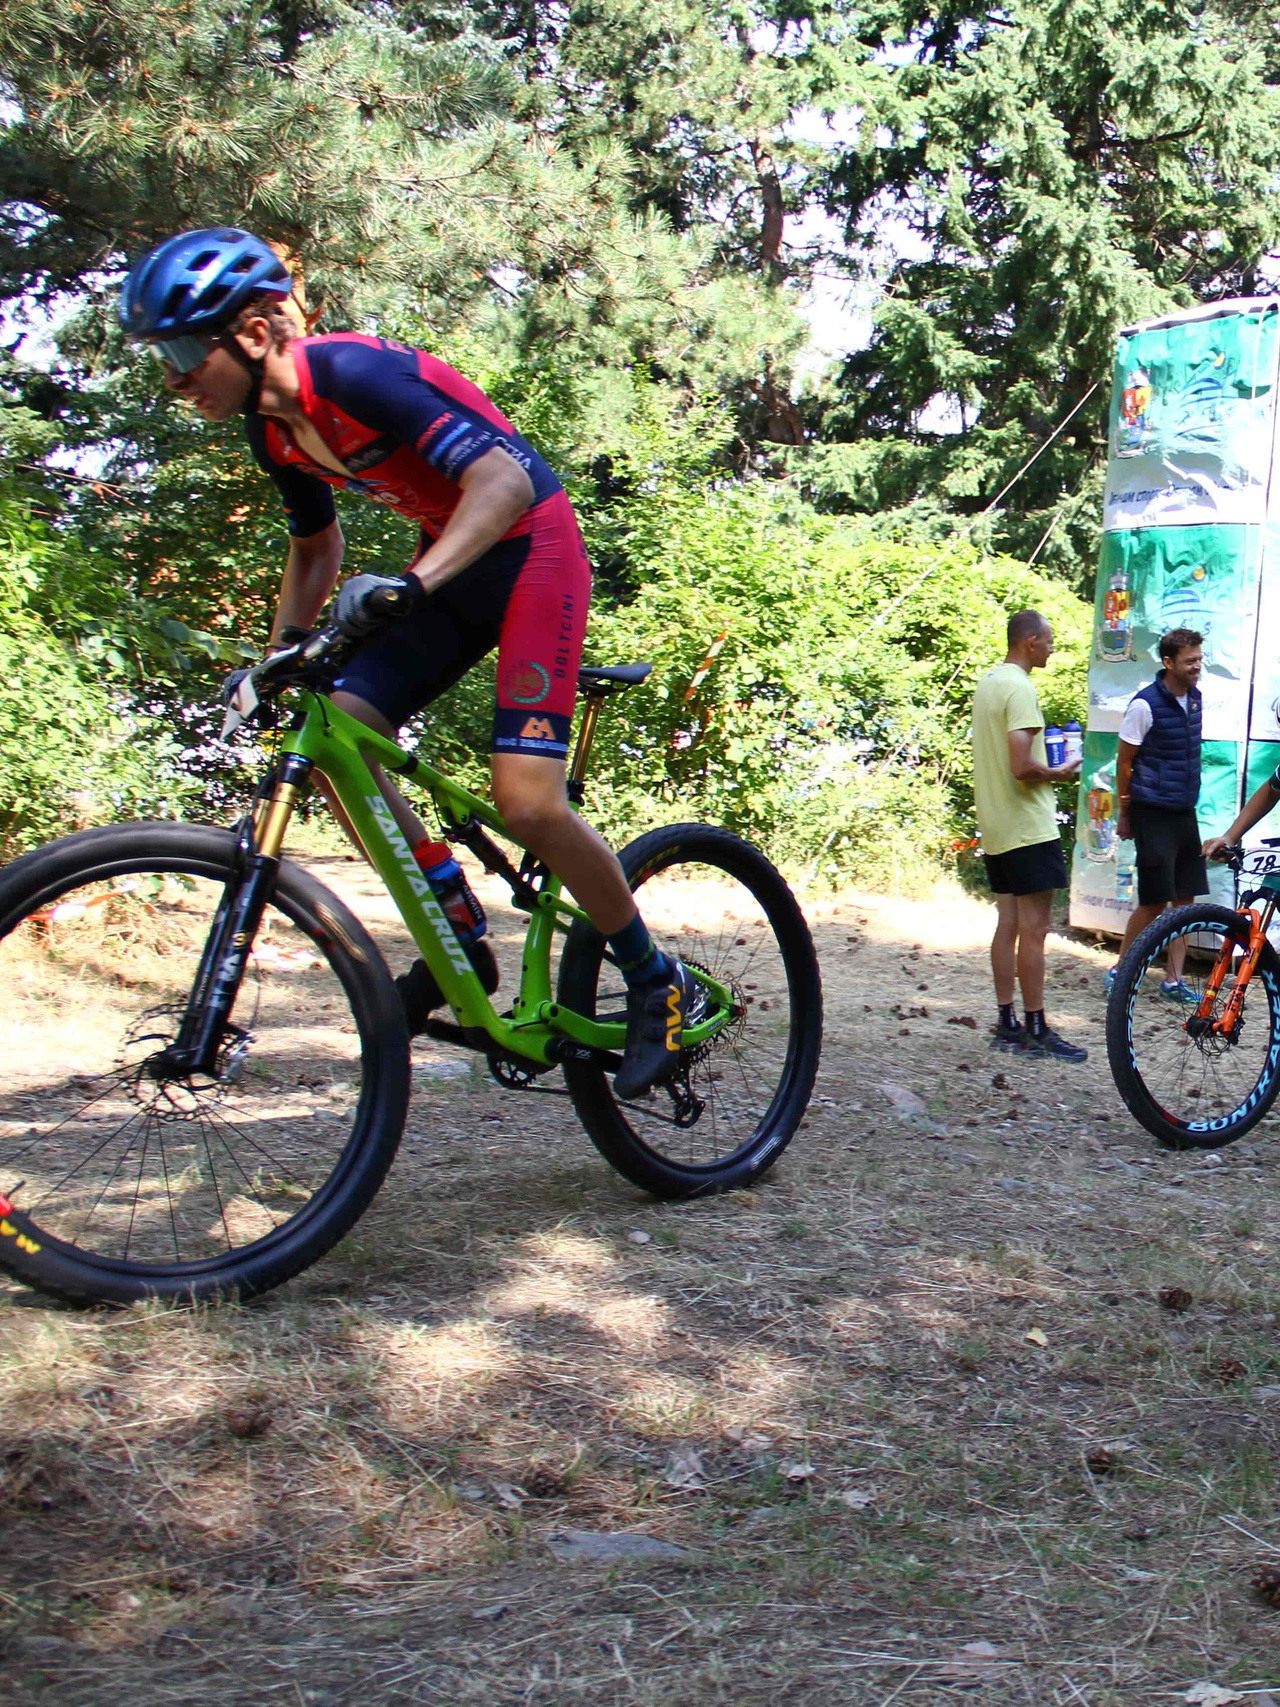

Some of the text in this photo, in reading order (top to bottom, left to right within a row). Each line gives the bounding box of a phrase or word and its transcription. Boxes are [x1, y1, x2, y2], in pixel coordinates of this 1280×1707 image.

[553, 593, 574, 679] DOLTCINI
[364, 795, 474, 976] SANTA CRUZ
[1253, 854, 1277, 873] 78
